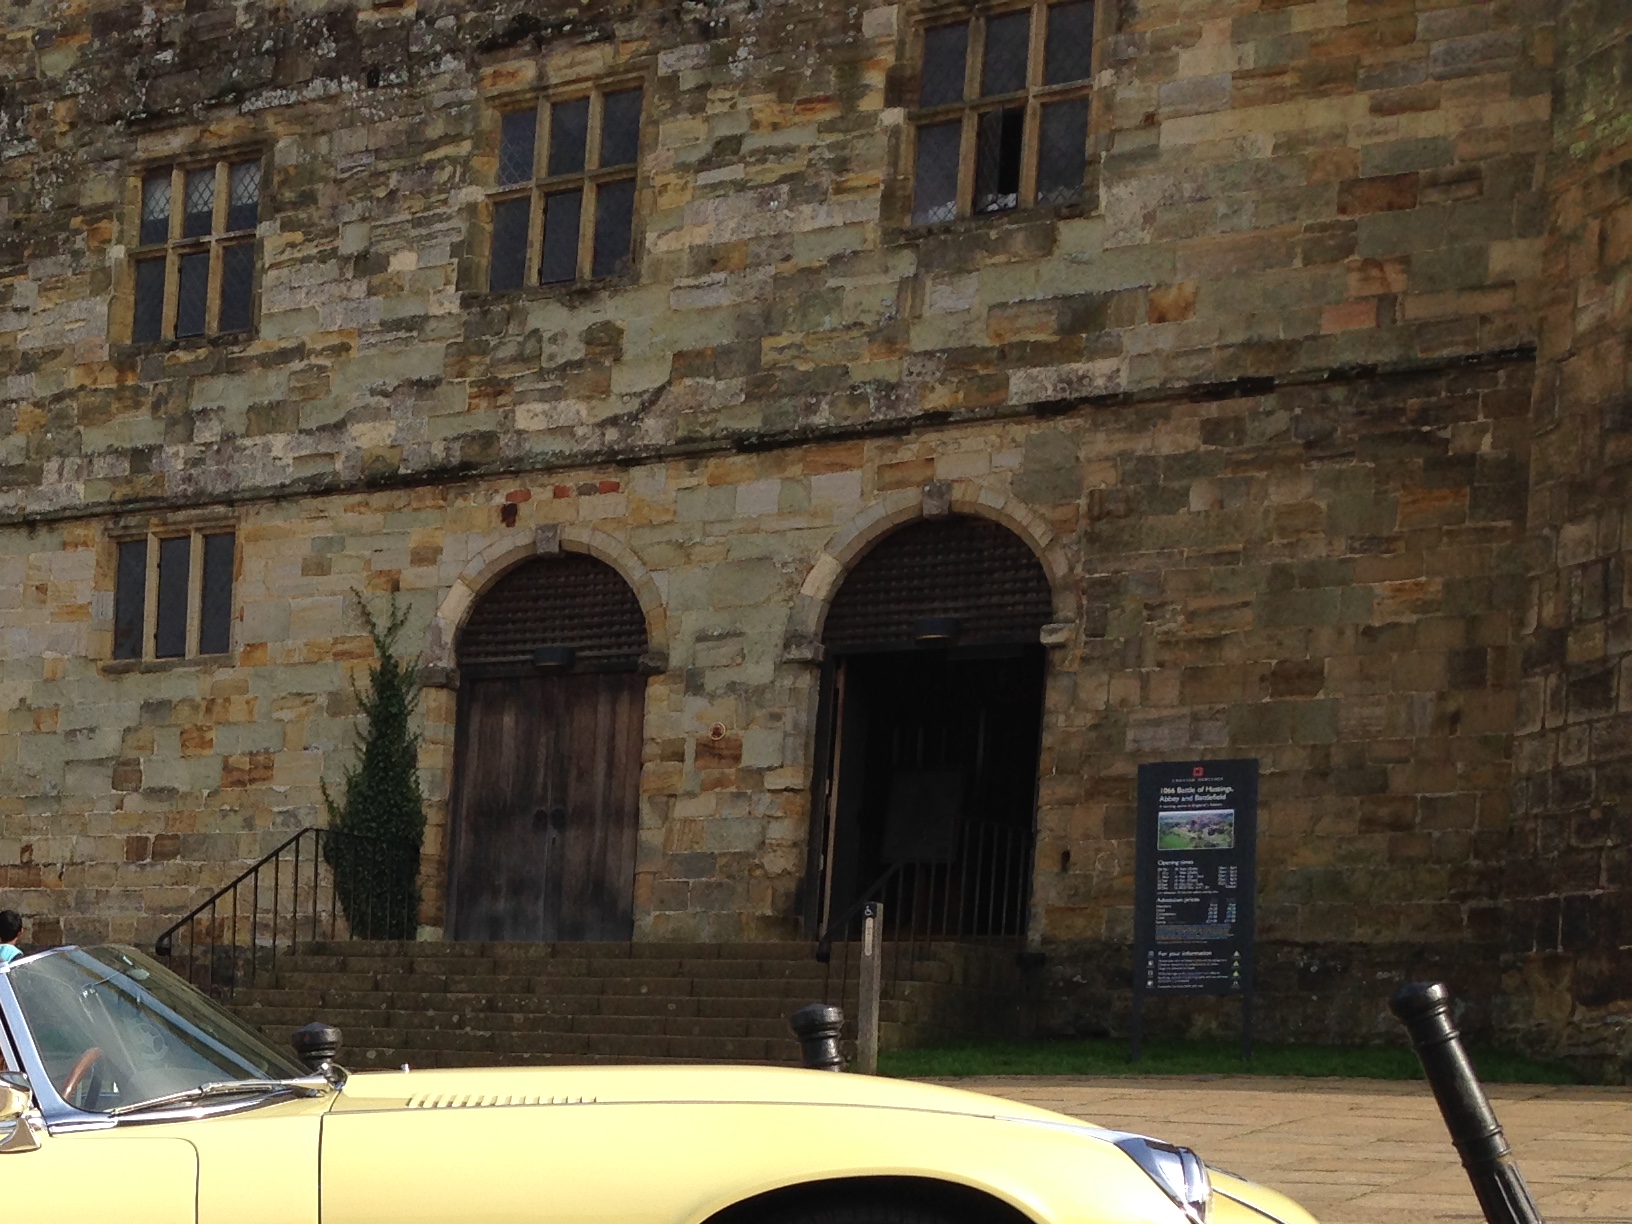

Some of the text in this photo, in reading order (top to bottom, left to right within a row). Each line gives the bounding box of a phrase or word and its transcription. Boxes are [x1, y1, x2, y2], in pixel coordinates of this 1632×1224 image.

[1177, 786, 1196, 794] Battle
[1197, 785, 1205, 793] of
[1159, 795, 1180, 803] Abbey
